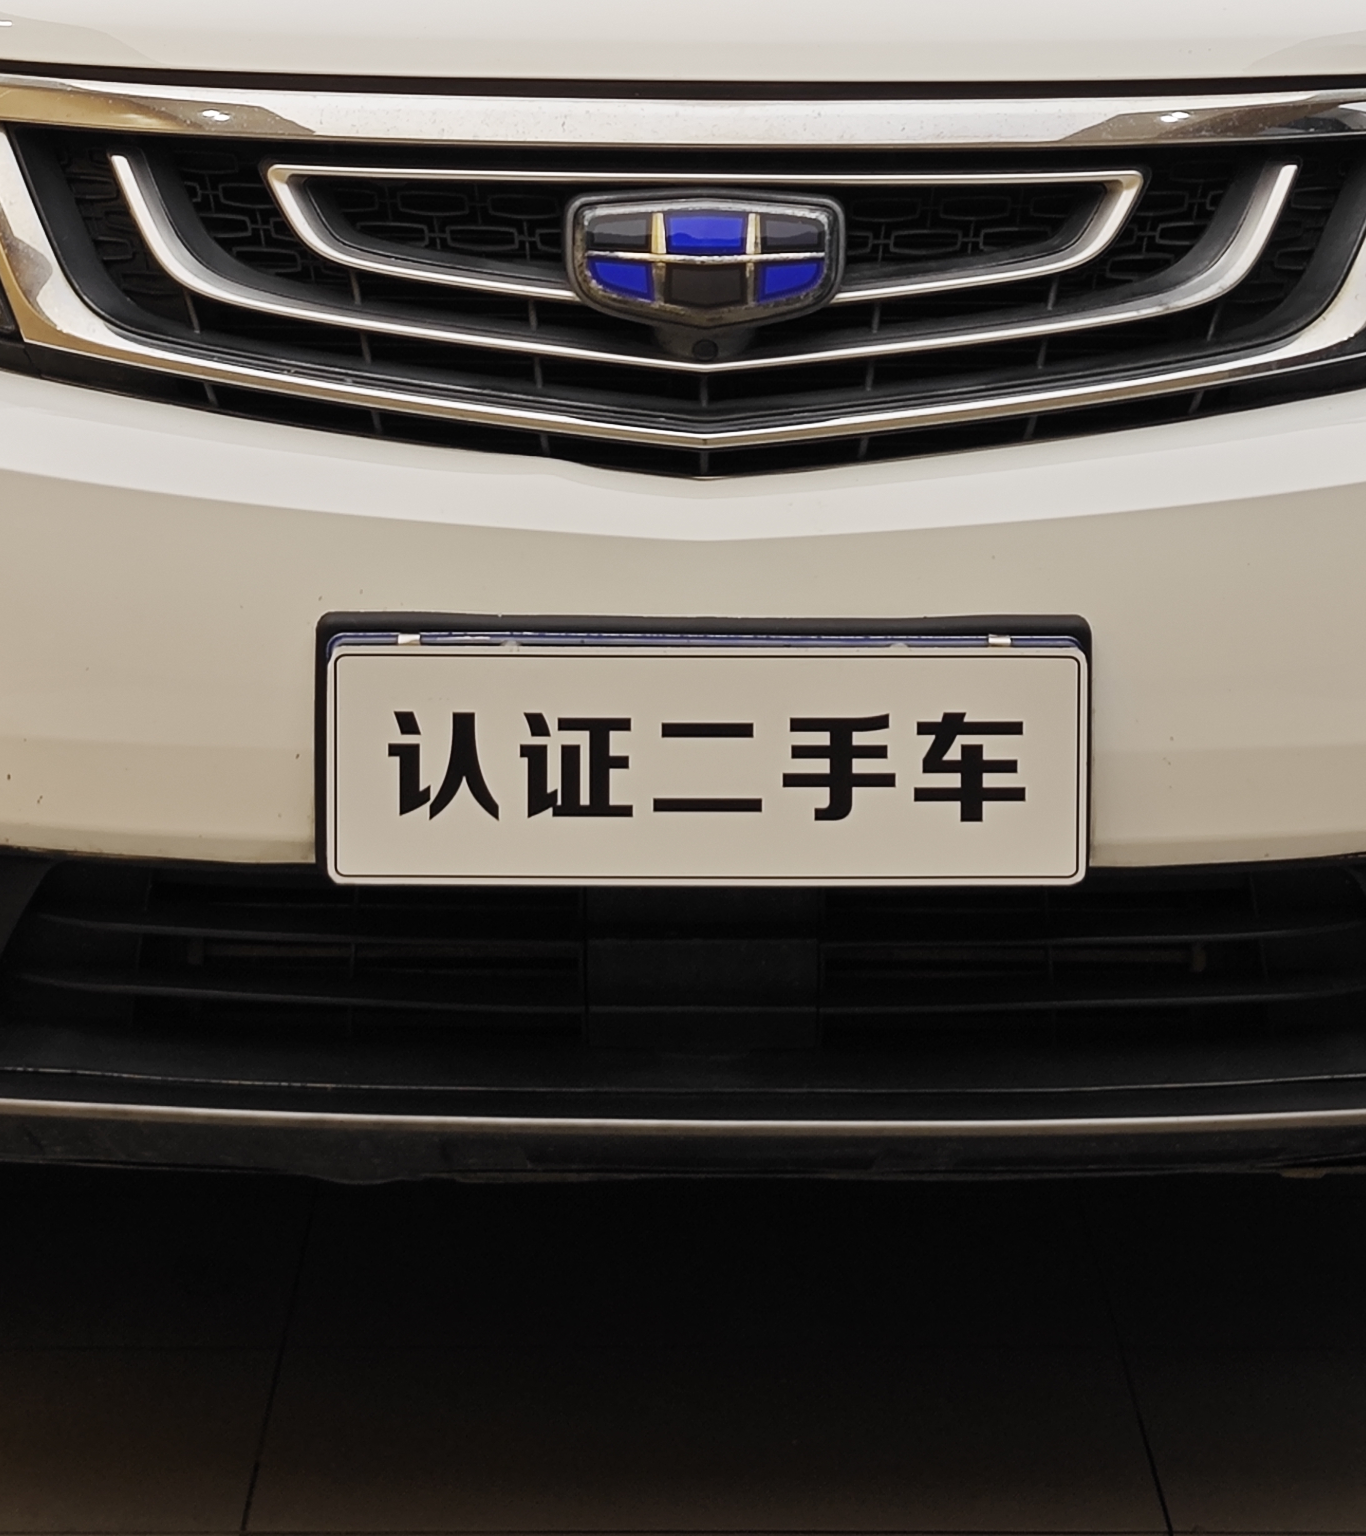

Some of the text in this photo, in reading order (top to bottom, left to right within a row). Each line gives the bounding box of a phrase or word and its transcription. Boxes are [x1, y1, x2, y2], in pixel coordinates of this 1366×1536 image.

[387, 710, 1027, 823] 认证二手车
